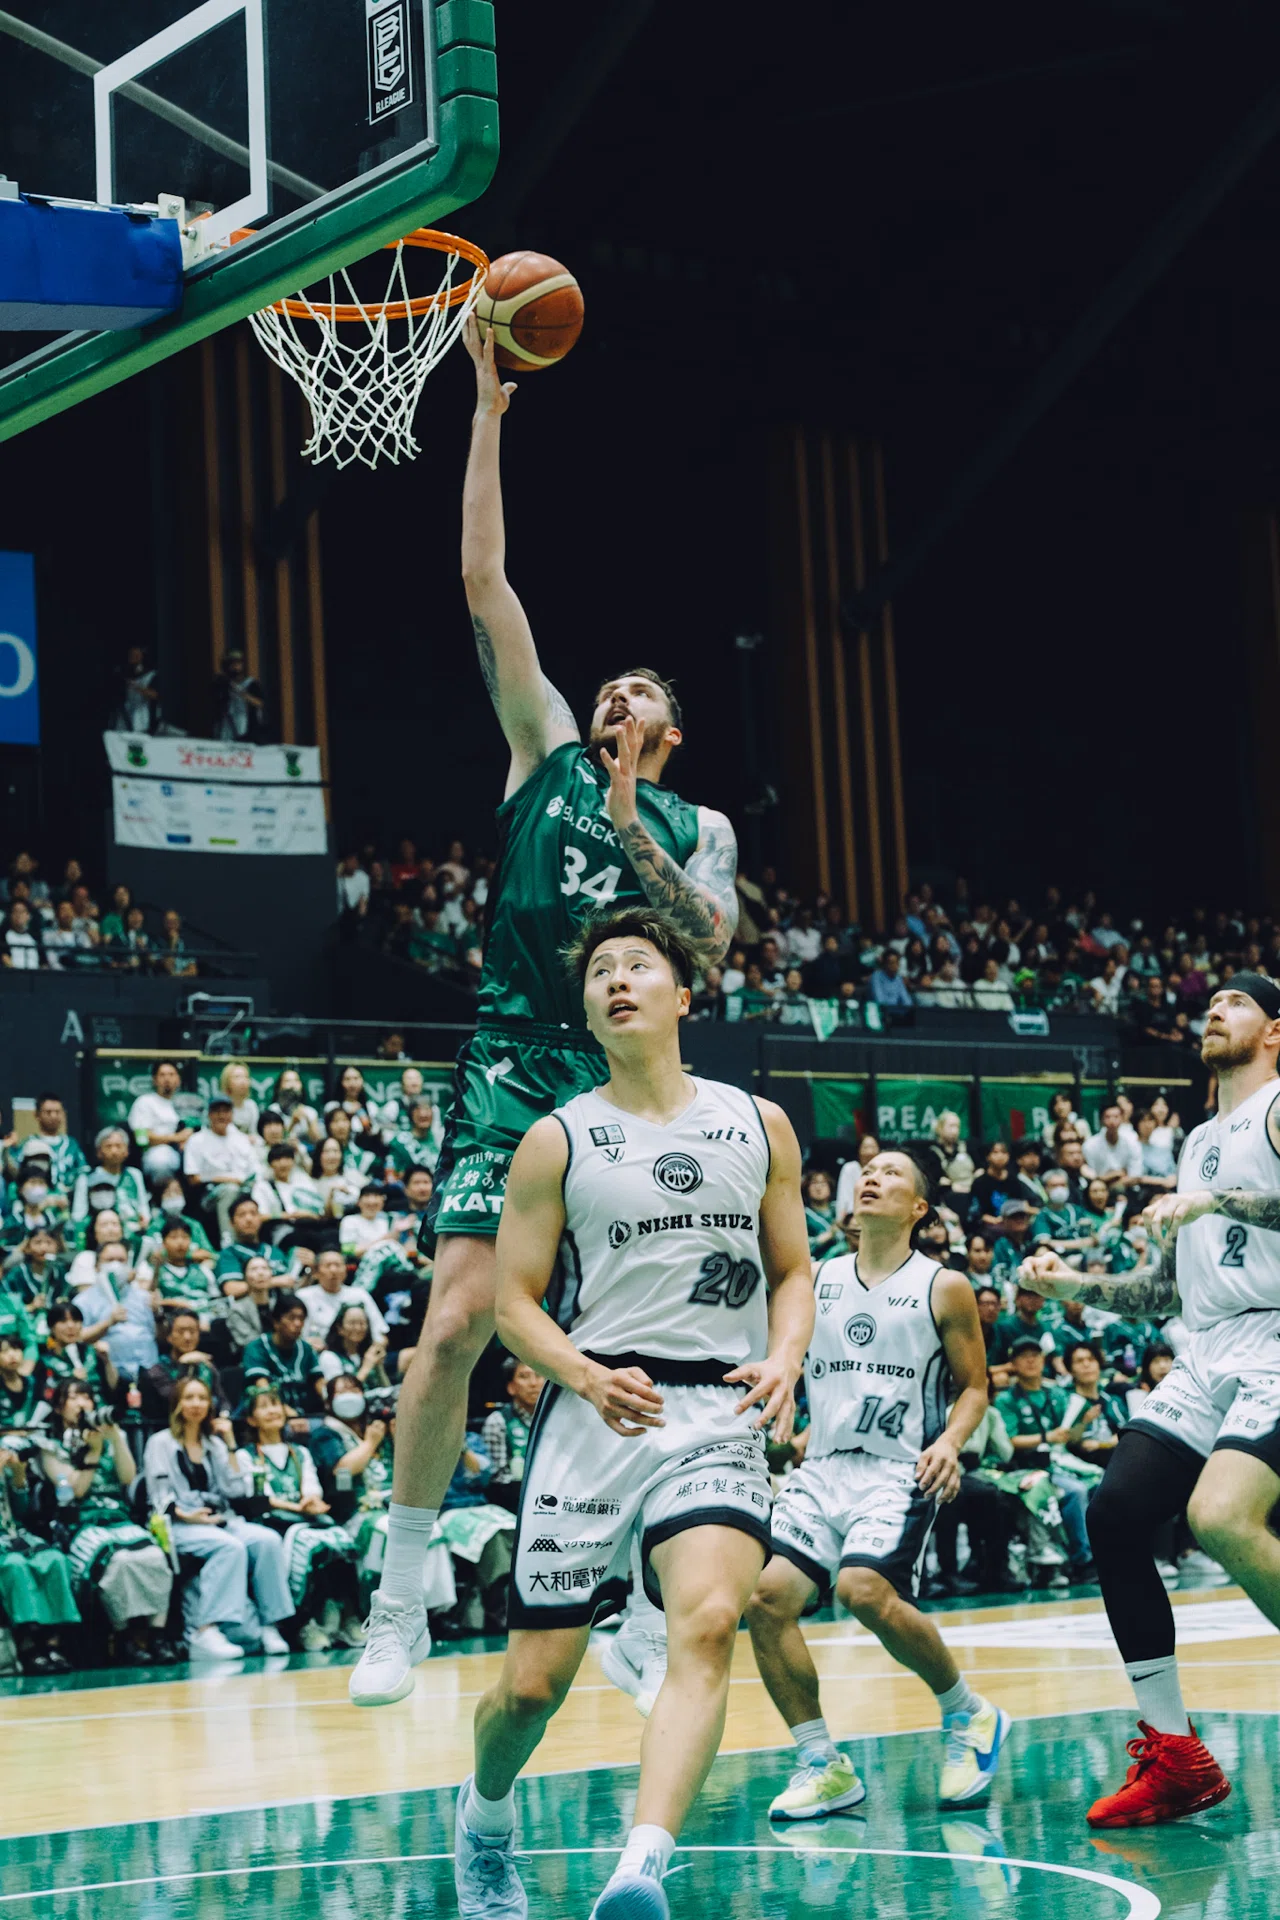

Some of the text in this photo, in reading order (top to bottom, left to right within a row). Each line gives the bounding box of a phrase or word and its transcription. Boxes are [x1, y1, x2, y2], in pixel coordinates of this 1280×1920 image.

[560, 845, 622, 909] 34
[60, 1010, 84, 1044] A
[442, 1192, 505, 1215] KAT
[637, 1213, 753, 1236] NISHI SHUZ
[1220, 1224, 1248, 1267] 2
[687, 1251, 761, 1310] 20
[829, 1360, 916, 1379] NISHI SHUZO
[855, 1395, 910, 1439] 14
